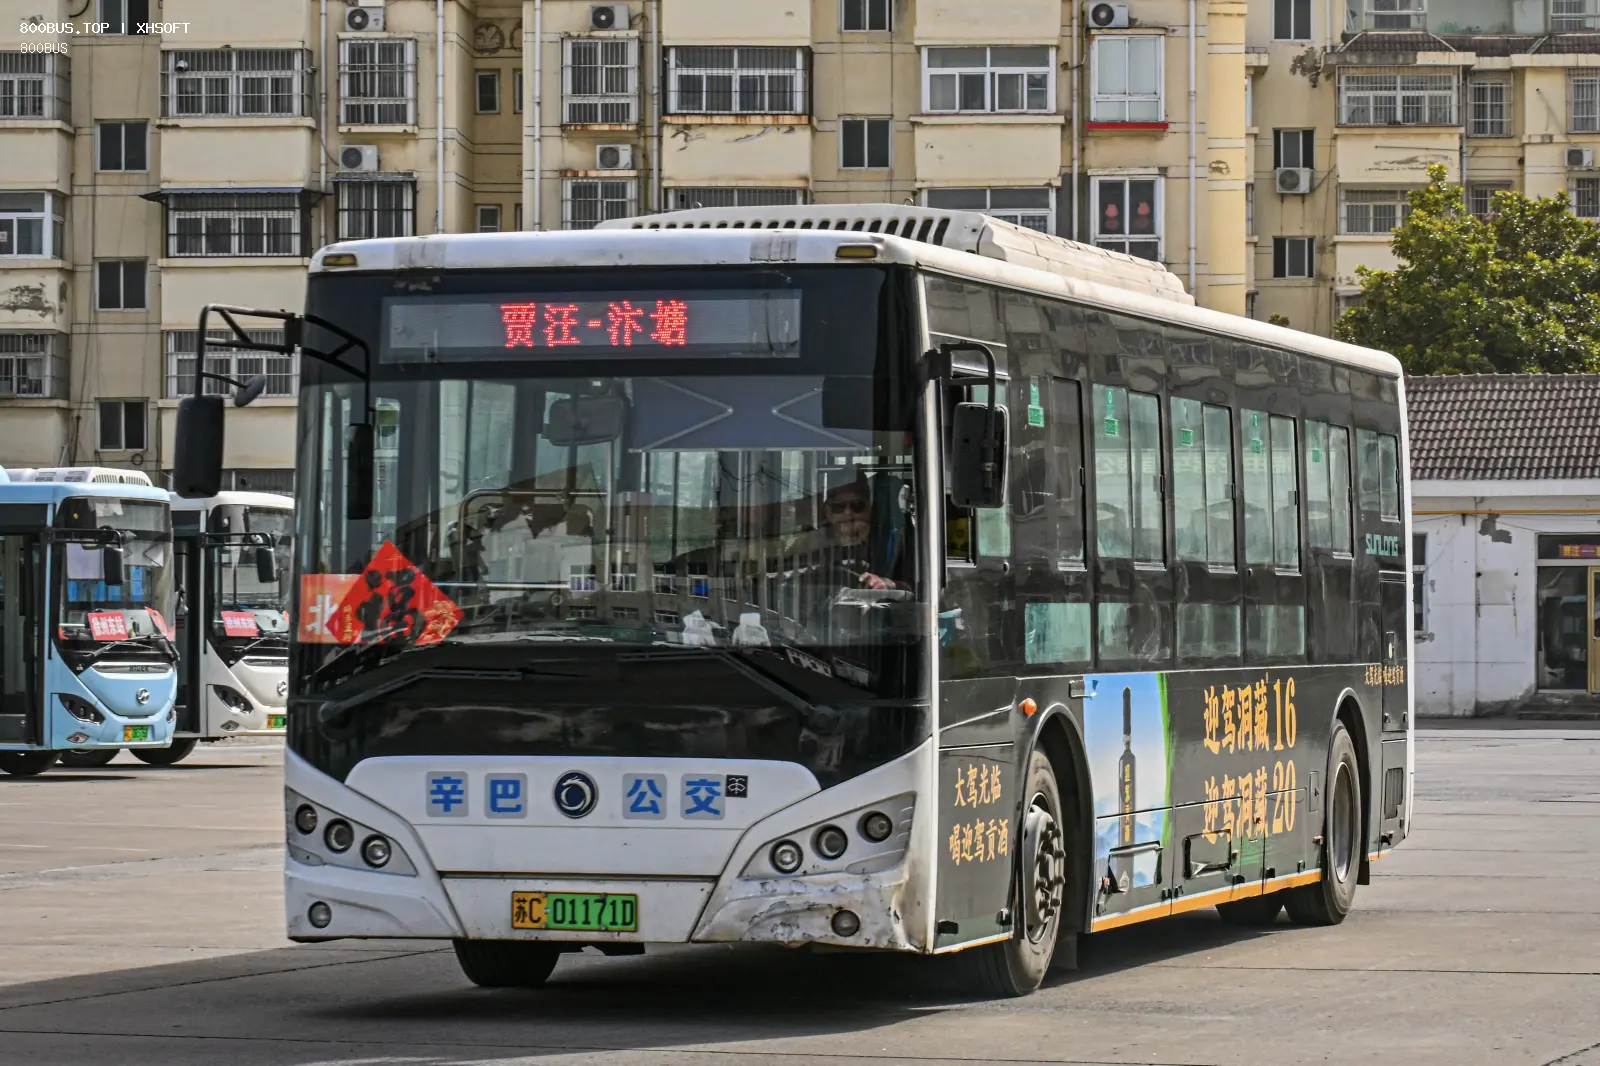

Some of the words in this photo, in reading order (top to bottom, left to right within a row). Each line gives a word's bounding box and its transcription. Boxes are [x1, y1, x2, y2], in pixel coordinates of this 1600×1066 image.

[429, 776, 523, 813] 辛巴
[627, 778, 721, 816] 公交
[954, 763, 1002, 809] 大驾光临
[949, 818, 1008, 866] 喝迎驾贡酒
